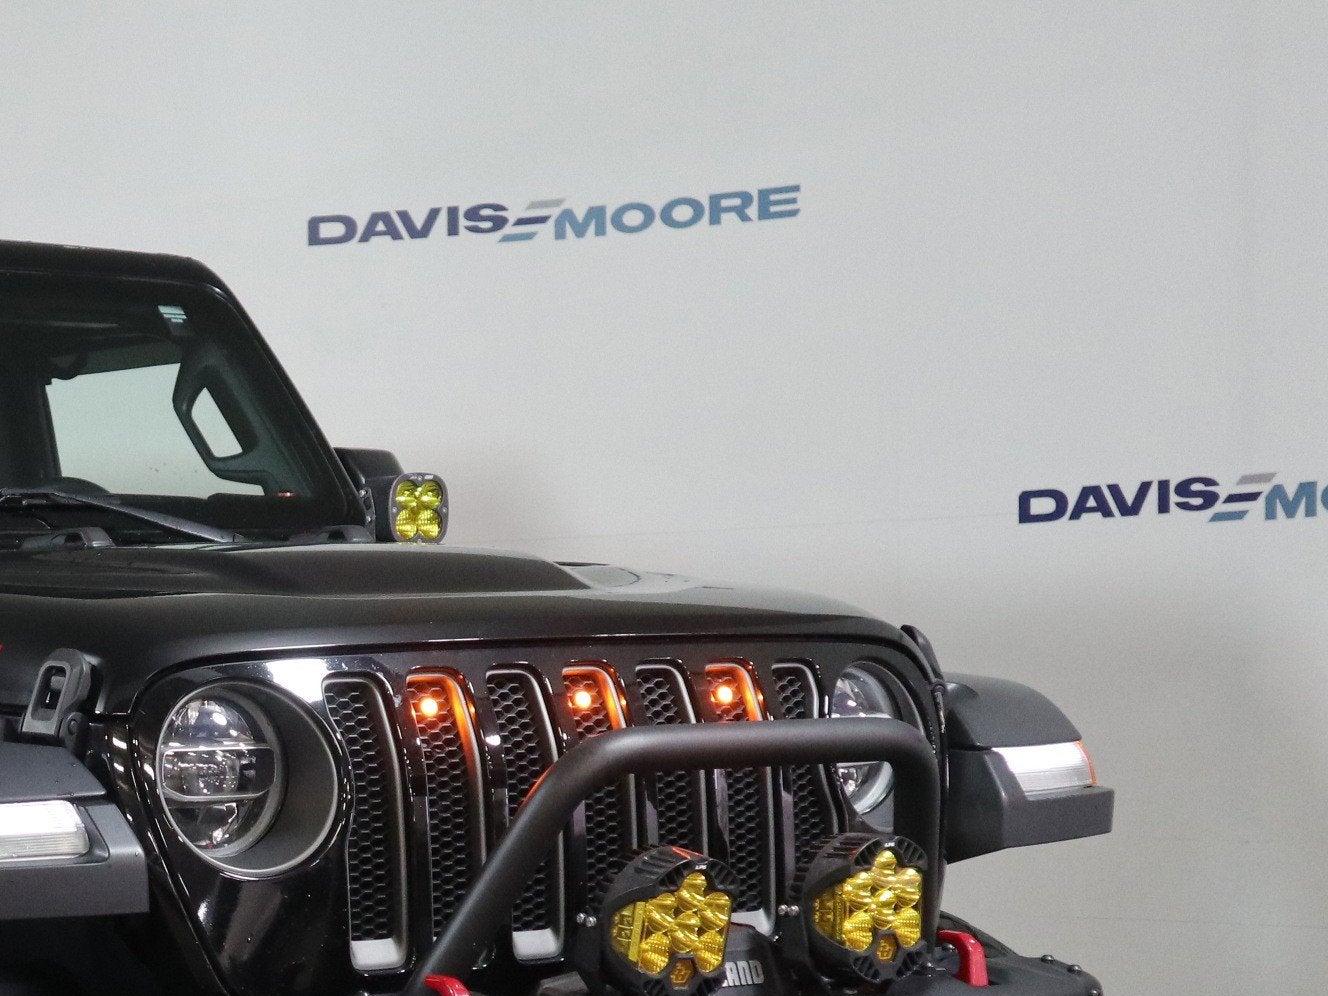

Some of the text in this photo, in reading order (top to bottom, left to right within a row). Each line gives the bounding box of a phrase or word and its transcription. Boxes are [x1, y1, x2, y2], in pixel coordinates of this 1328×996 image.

[307, 184, 801, 246] DAVIS MOORE
[1018, 477, 1328, 524] DAVIS M
[721, 960, 765, 987] AND
